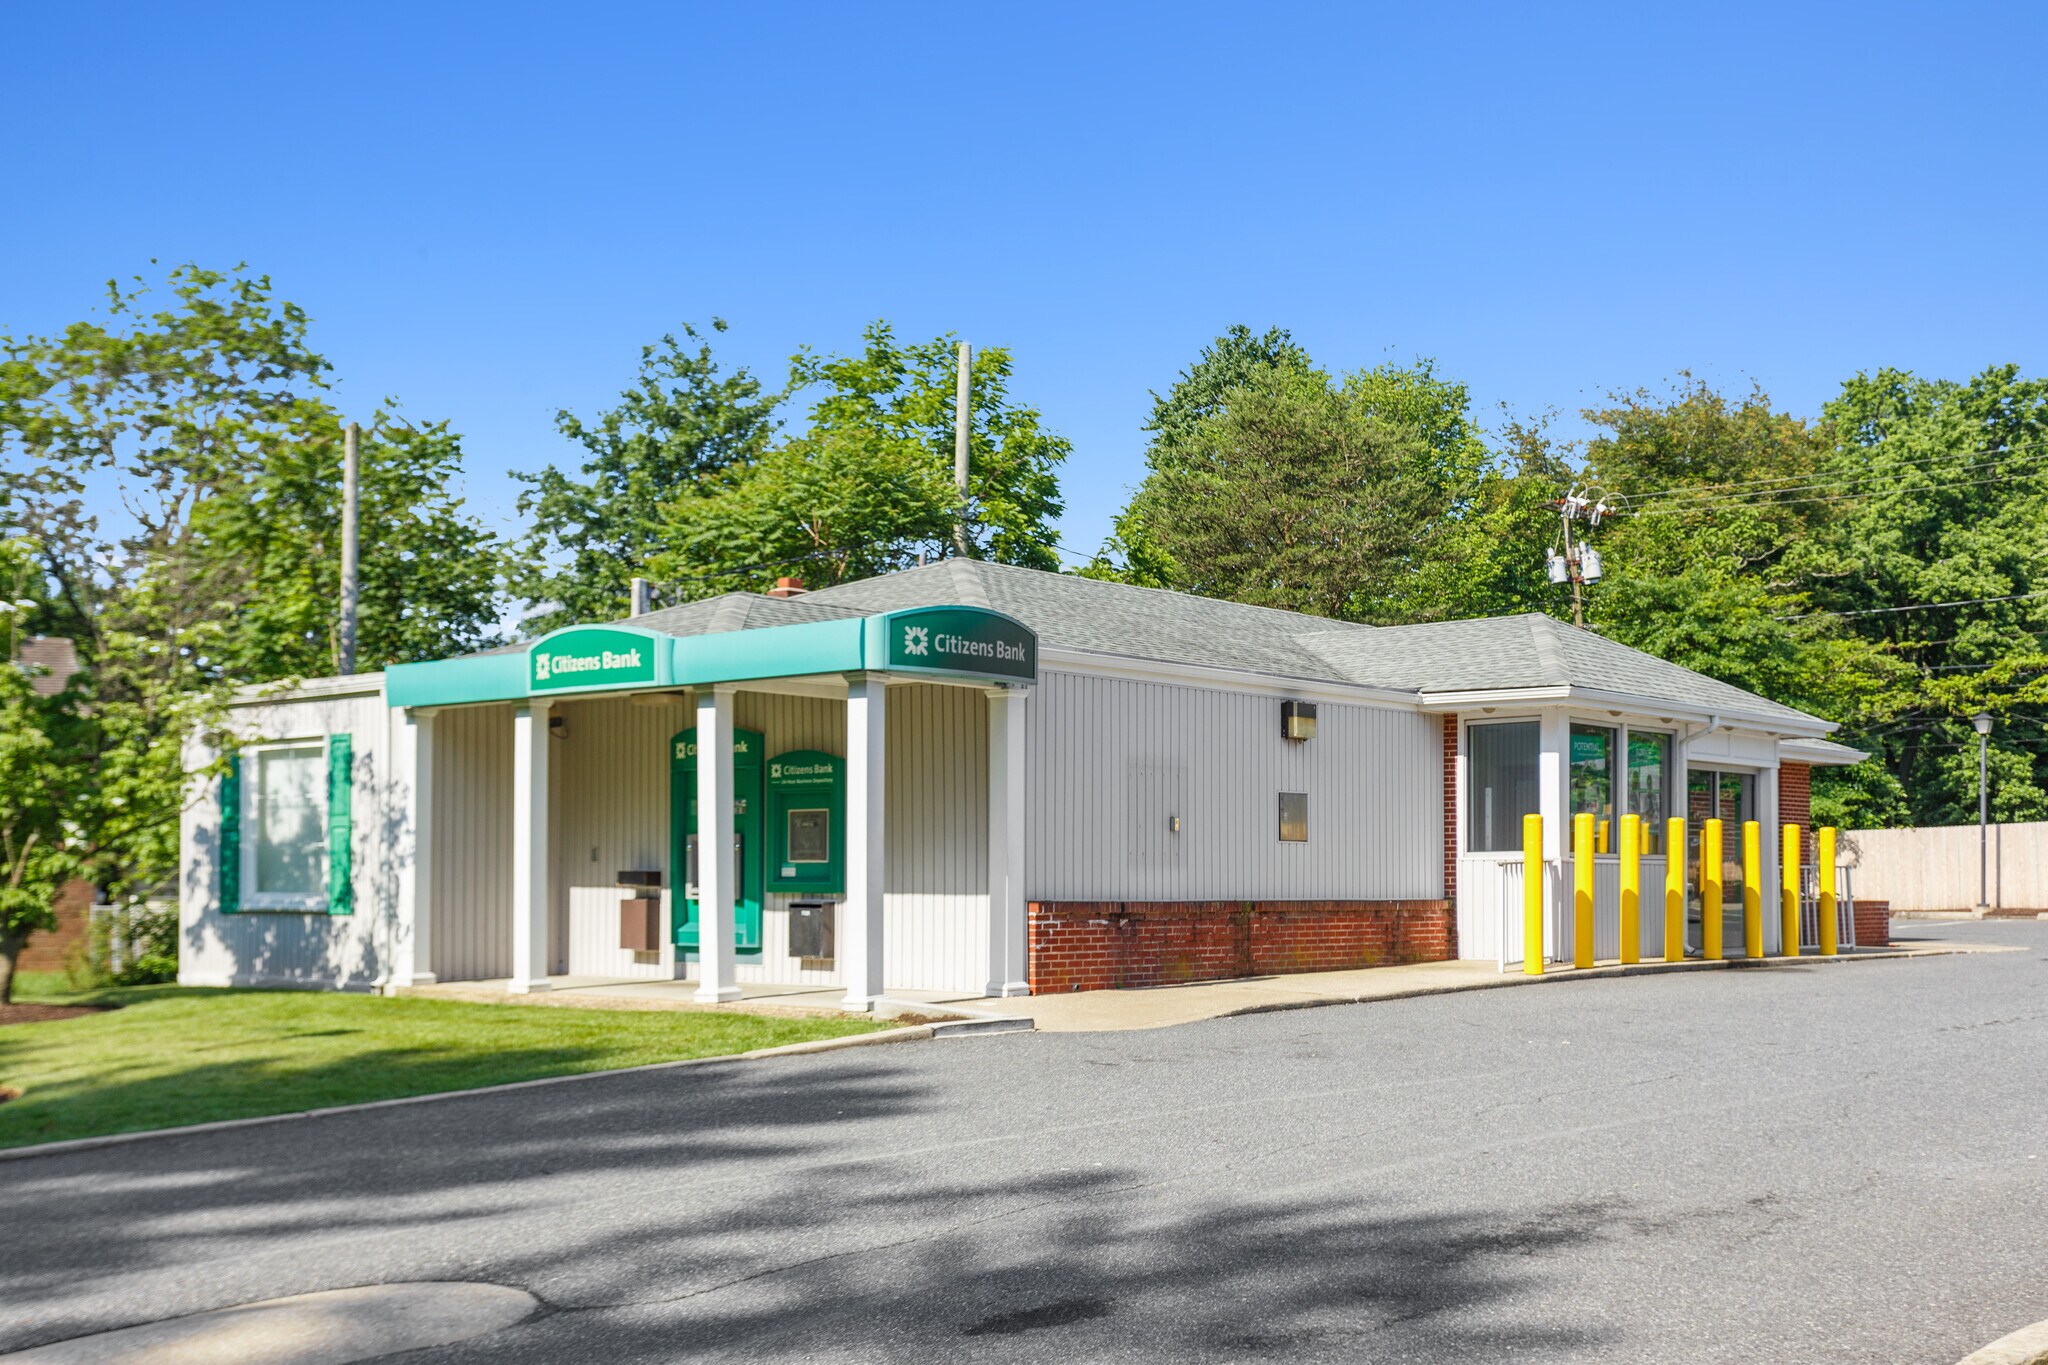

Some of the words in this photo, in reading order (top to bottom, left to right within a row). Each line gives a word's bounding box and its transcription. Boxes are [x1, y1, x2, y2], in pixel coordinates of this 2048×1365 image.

[551, 654, 601, 674] Citizens
[602, 648, 641, 669] Bank
[934, 634, 994, 657] Citizens
[996, 640, 1025, 662] Bank
[783, 765, 813, 775] Citizens
[813, 763, 833, 774] Bank
